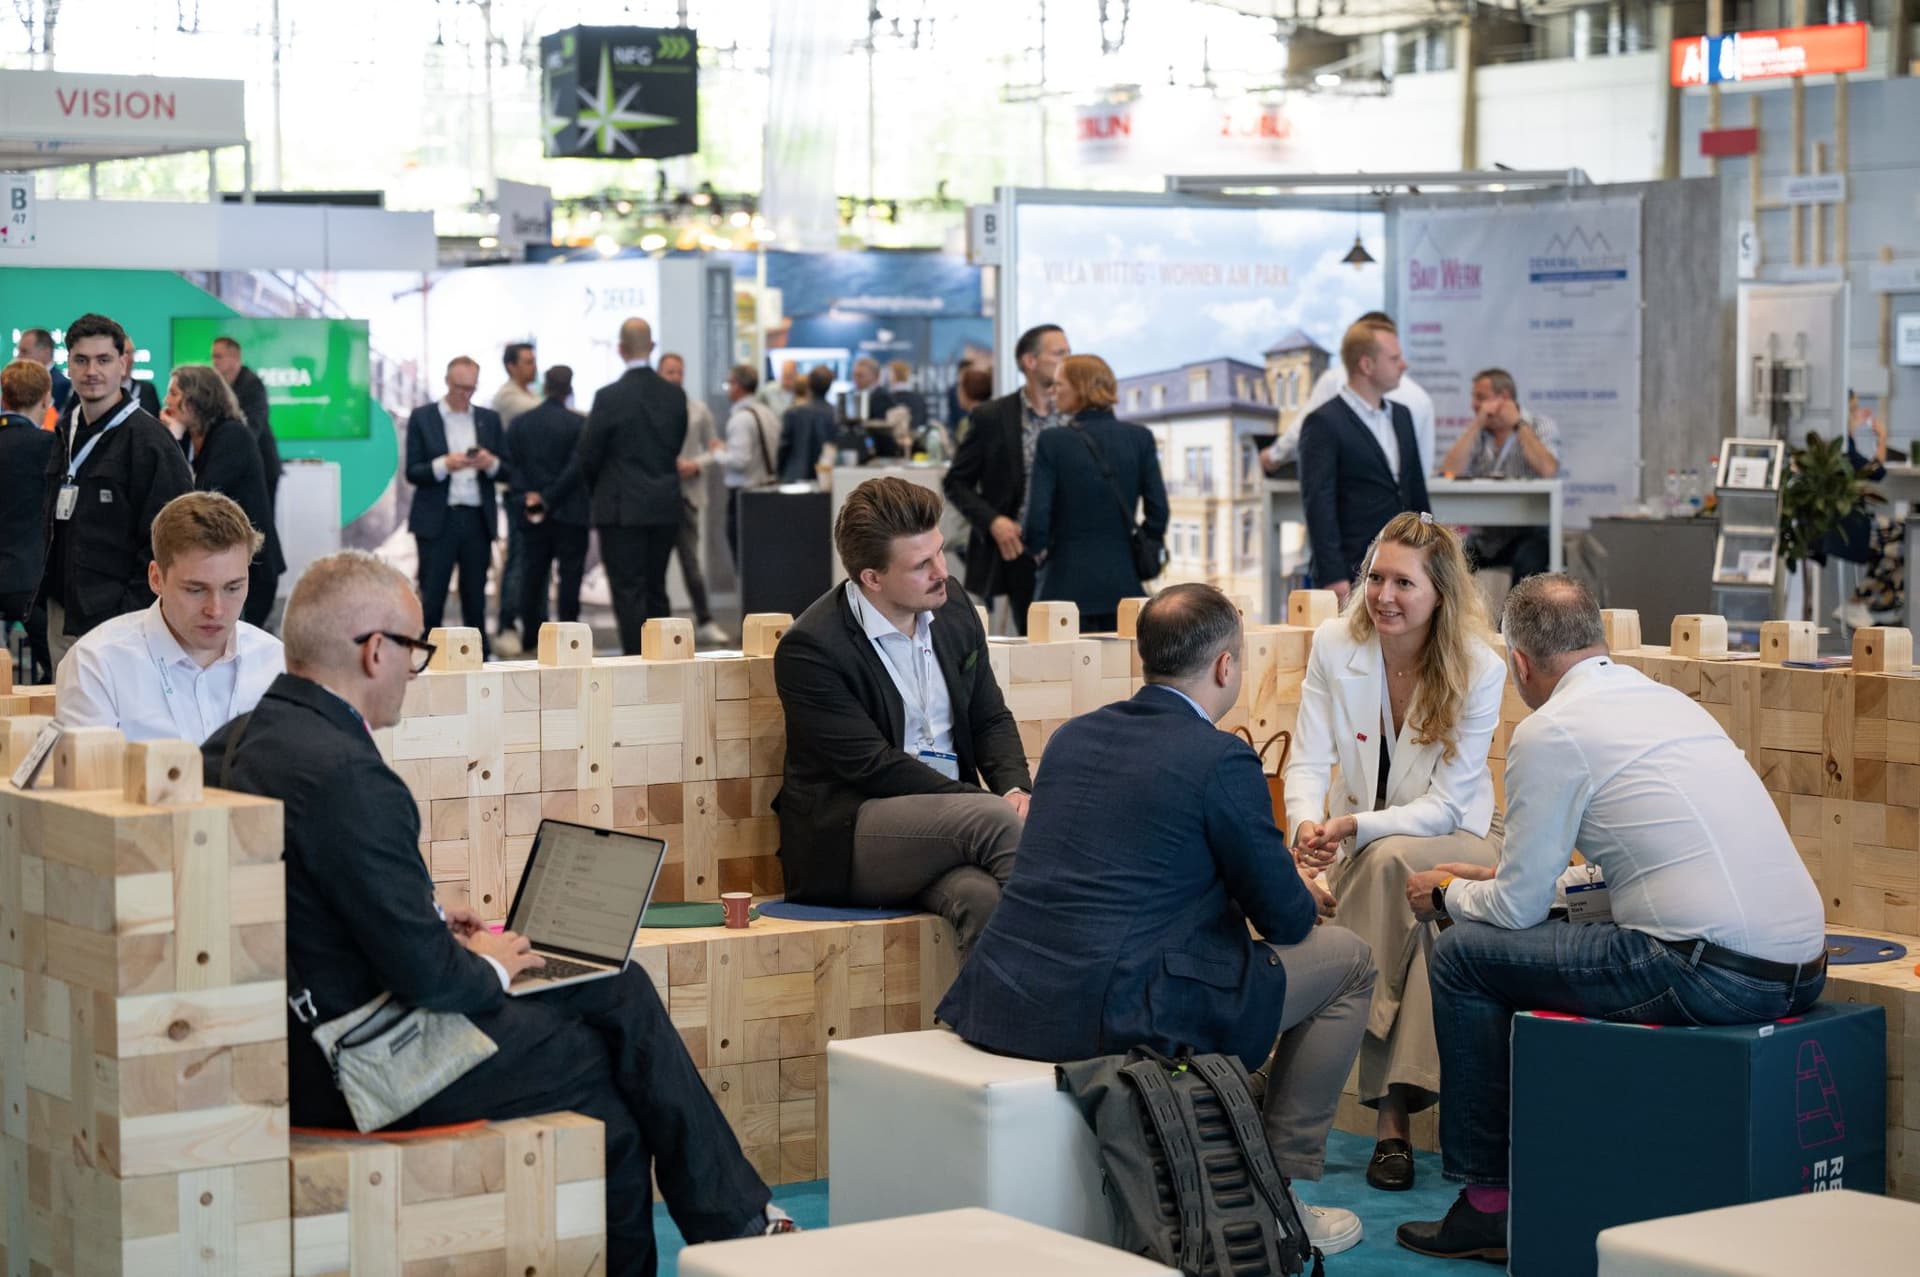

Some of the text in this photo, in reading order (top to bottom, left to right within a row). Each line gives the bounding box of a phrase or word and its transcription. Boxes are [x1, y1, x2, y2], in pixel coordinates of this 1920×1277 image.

[56, 88, 176, 120] VISION
[11, 187, 27, 211] B
[12, 213, 26, 225] 47
[984, 213, 997, 234] B
[1043, 258, 1087, 285] VILLA
[1158, 262, 1223, 287] WOHNEN
[1225, 263, 1249, 286] AM
[1254, 263, 1290, 287] PARK
